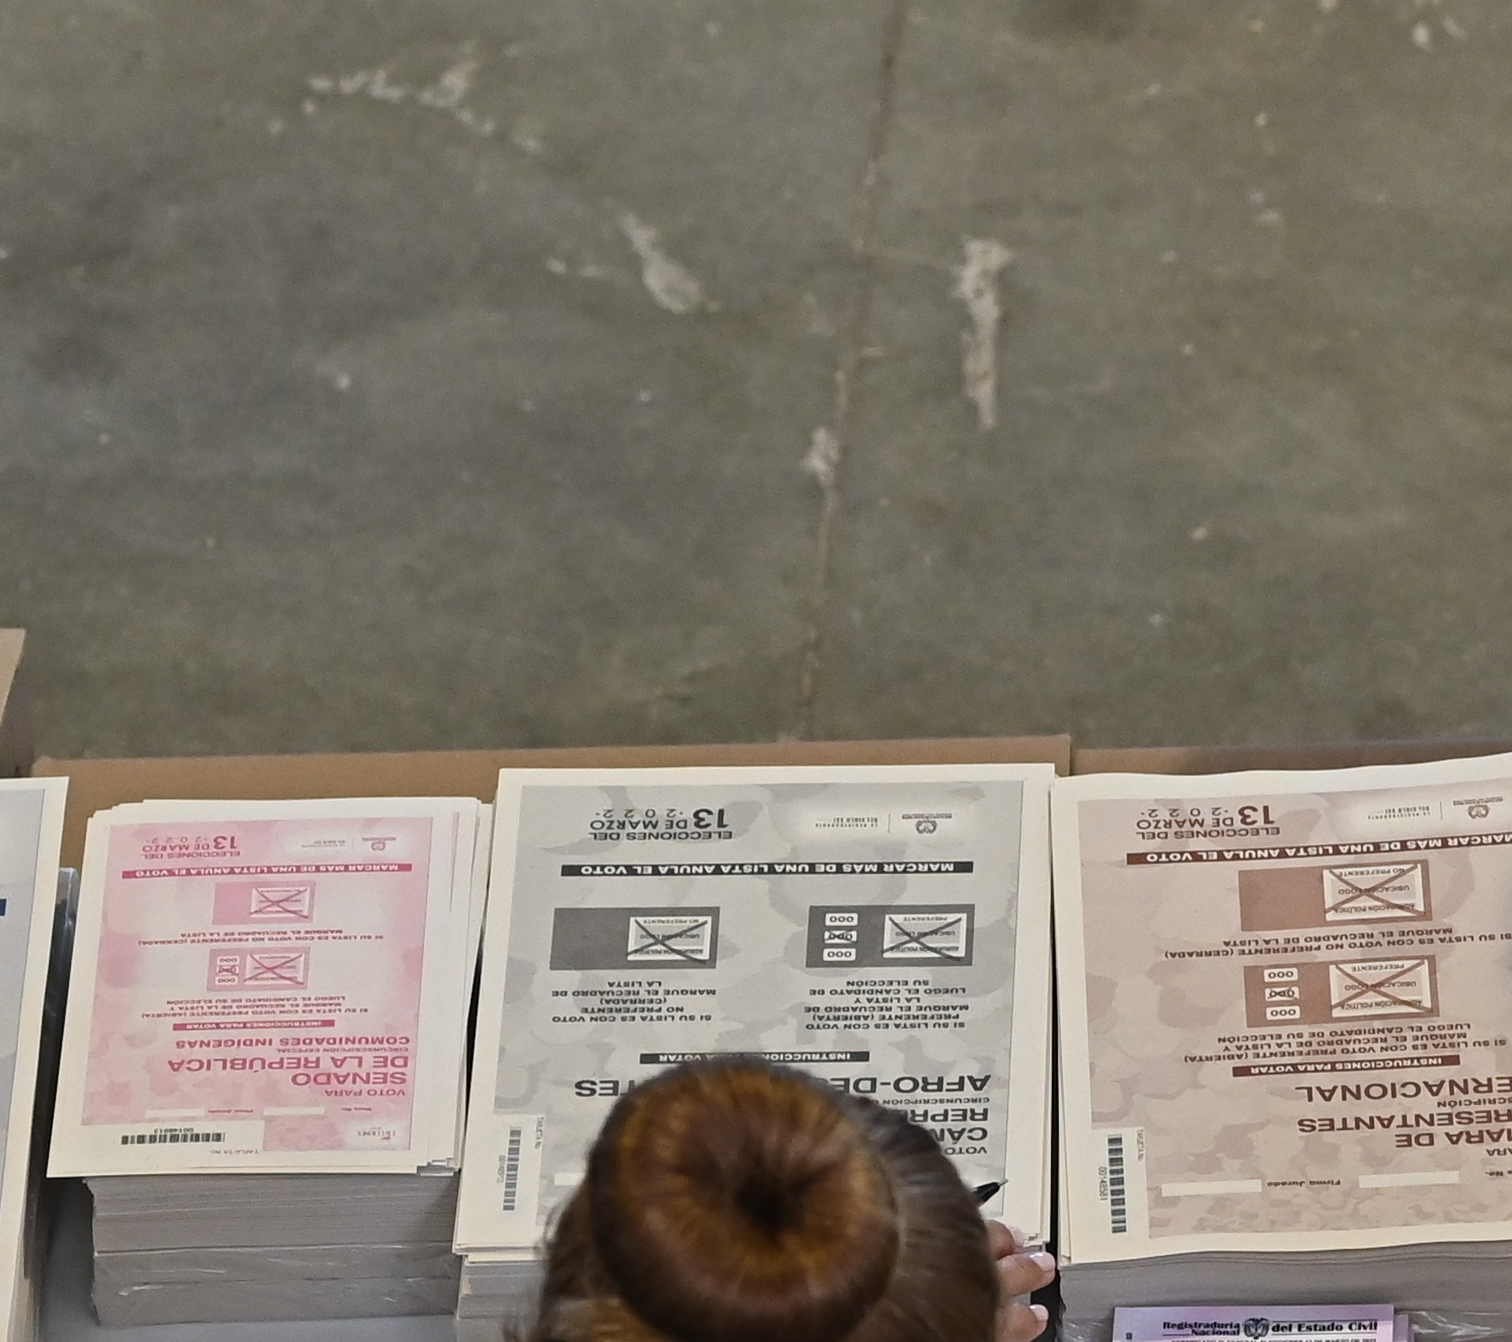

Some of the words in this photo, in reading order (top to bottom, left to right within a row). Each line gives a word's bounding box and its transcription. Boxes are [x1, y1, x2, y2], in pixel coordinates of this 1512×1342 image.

[693, 809, 728, 829] 13
[1238, 805, 1275, 826] 13
[591, 820, 659, 830] MARZO
[666, 820, 688, 830] DE
[1137, 818, 1205, 830] MARZO
[1212, 817, 1234, 828] DE
[626, 832, 733, 841] ELECCIONES
[1136, 831, 1169, 840] DEL
[1174, 827, 1280, 840] ELECCIONES
[214, 836, 236, 850] 13
[581, 866, 627, 875] VOTO
[816, 864, 837, 873] DE
[176, 1039, 273, 1048] INDÍGENAS
[280, 1036, 410, 1046] COMUNIDADES
[168, 1057, 321, 1072] REPÚBLICA
[331, 1057, 363, 1069] LA
[373, 1056, 409, 1069] DE
[1336, 1058, 1442, 1070] INSTRUCCIONES
[292, 1072, 407, 1086] SENADO
[1395, 1133, 1435, 1148] DE
[943, 1147, 988, 1156] VOTO
[1272, 1322, 1292, 1333] del
[1298, 1321, 1343, 1332] Estado
[1349, 1320, 1378, 1331] Civil
